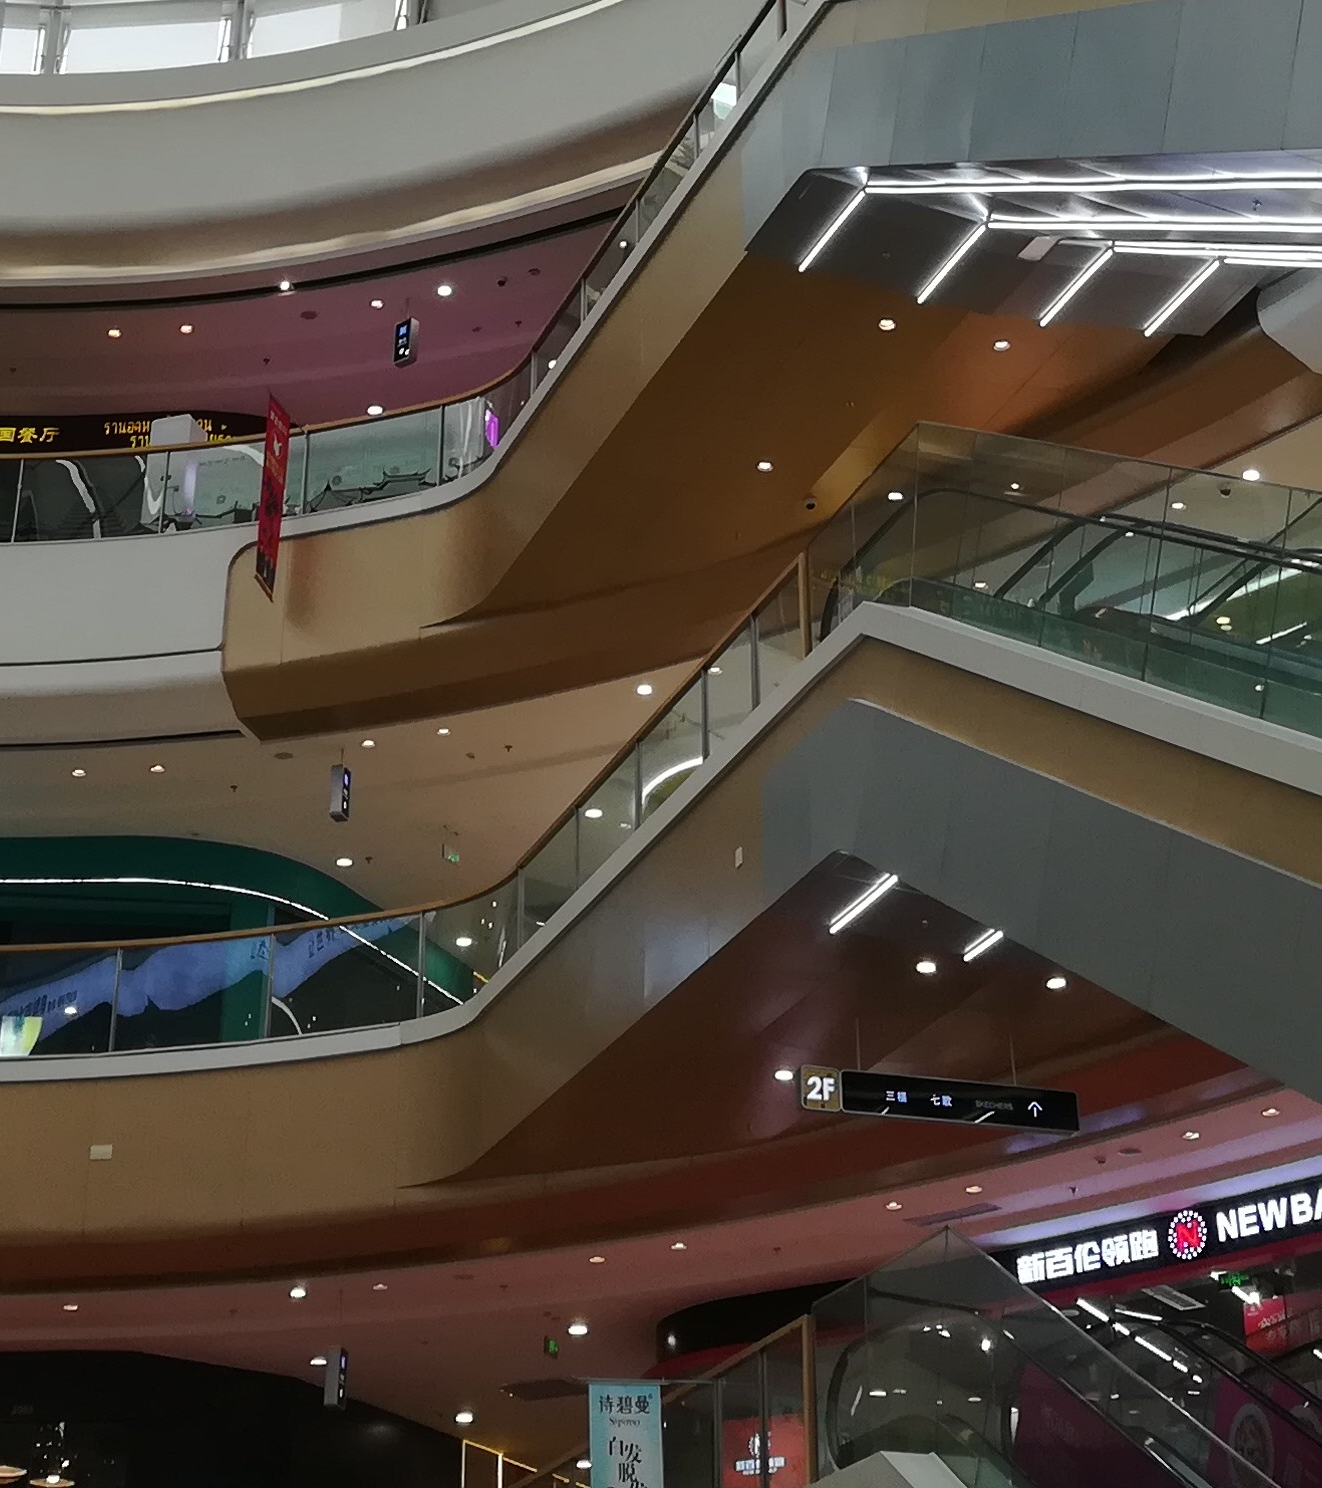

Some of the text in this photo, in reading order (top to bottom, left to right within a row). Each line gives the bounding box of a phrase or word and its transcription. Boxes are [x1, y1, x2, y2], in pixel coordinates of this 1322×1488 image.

[806, 1075, 837, 1101] 2F
[1016, 1228, 1159, 1285] 新百伦领跑
[598, 1394, 650, 1414] 诗碧曼
